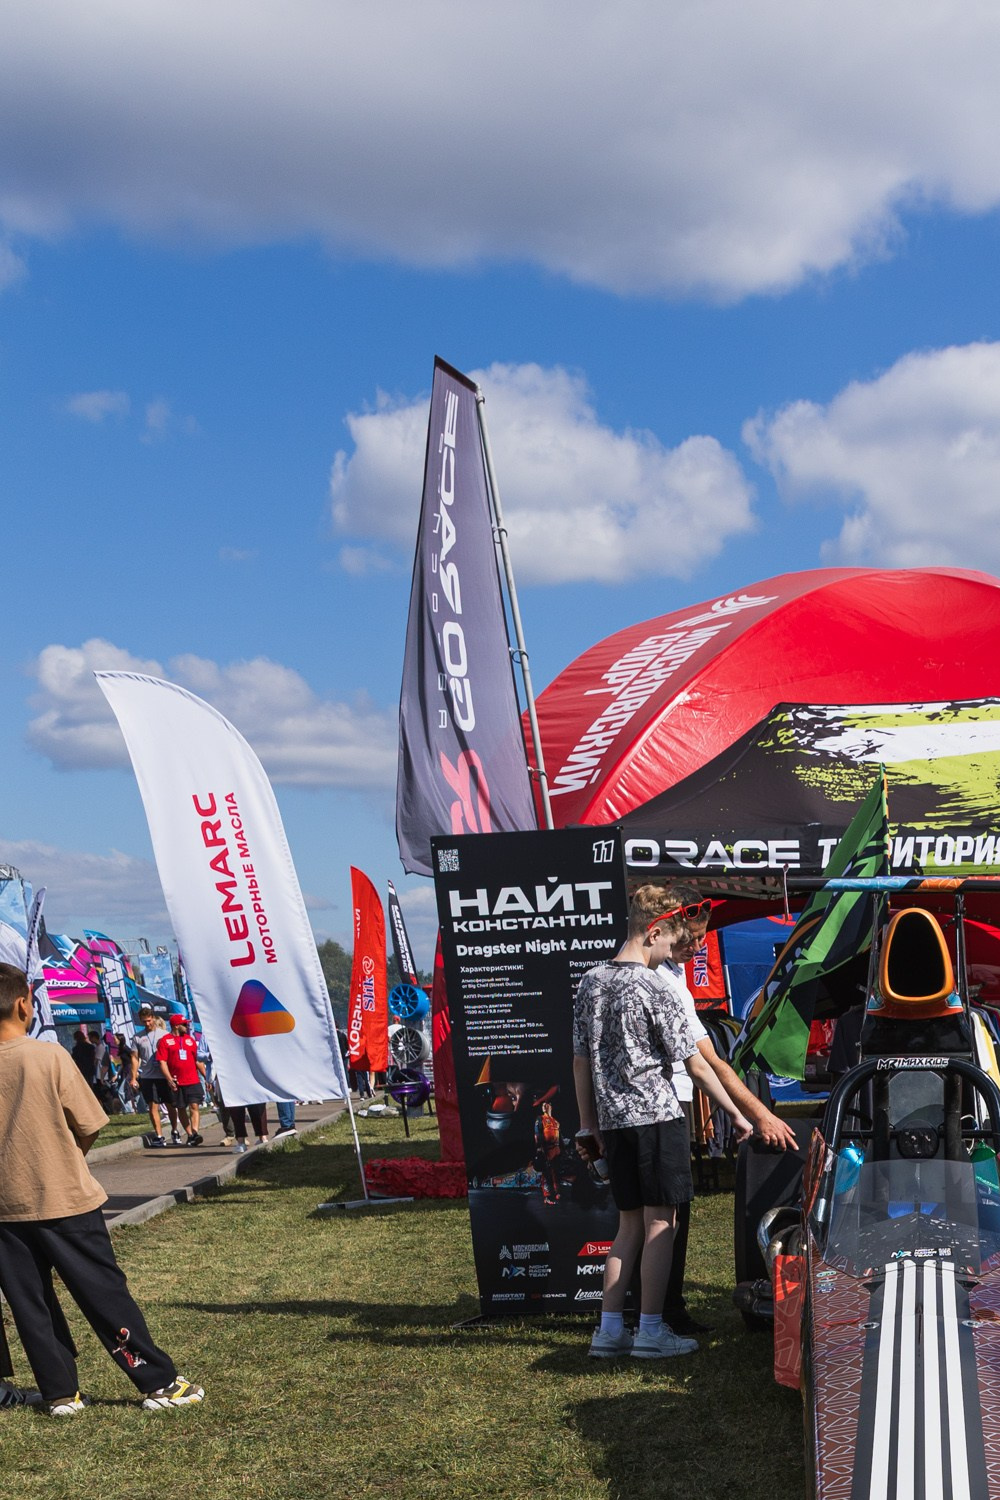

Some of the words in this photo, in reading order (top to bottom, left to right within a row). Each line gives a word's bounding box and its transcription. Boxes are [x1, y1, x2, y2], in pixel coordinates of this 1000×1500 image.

[584, 631, 688, 696] СПОРТ
[548, 622, 733, 797] МОСКОВСКИЙ
[224, 792, 251, 858] МАСЛА
[592, 839, 615, 863] 11
[192, 792, 256, 967] LEMARC
[448, 876, 613, 917] НАЙТ
[242, 863, 278, 964] МОТОРНЫЕ
[453, 913, 614, 933] КОНСТАНТИН
[456, 943, 522, 958] Dragster
[525, 939, 567, 955] Night
[571, 938, 616, 951] Arrow
[460, 964, 524, 974] Характеристики:
